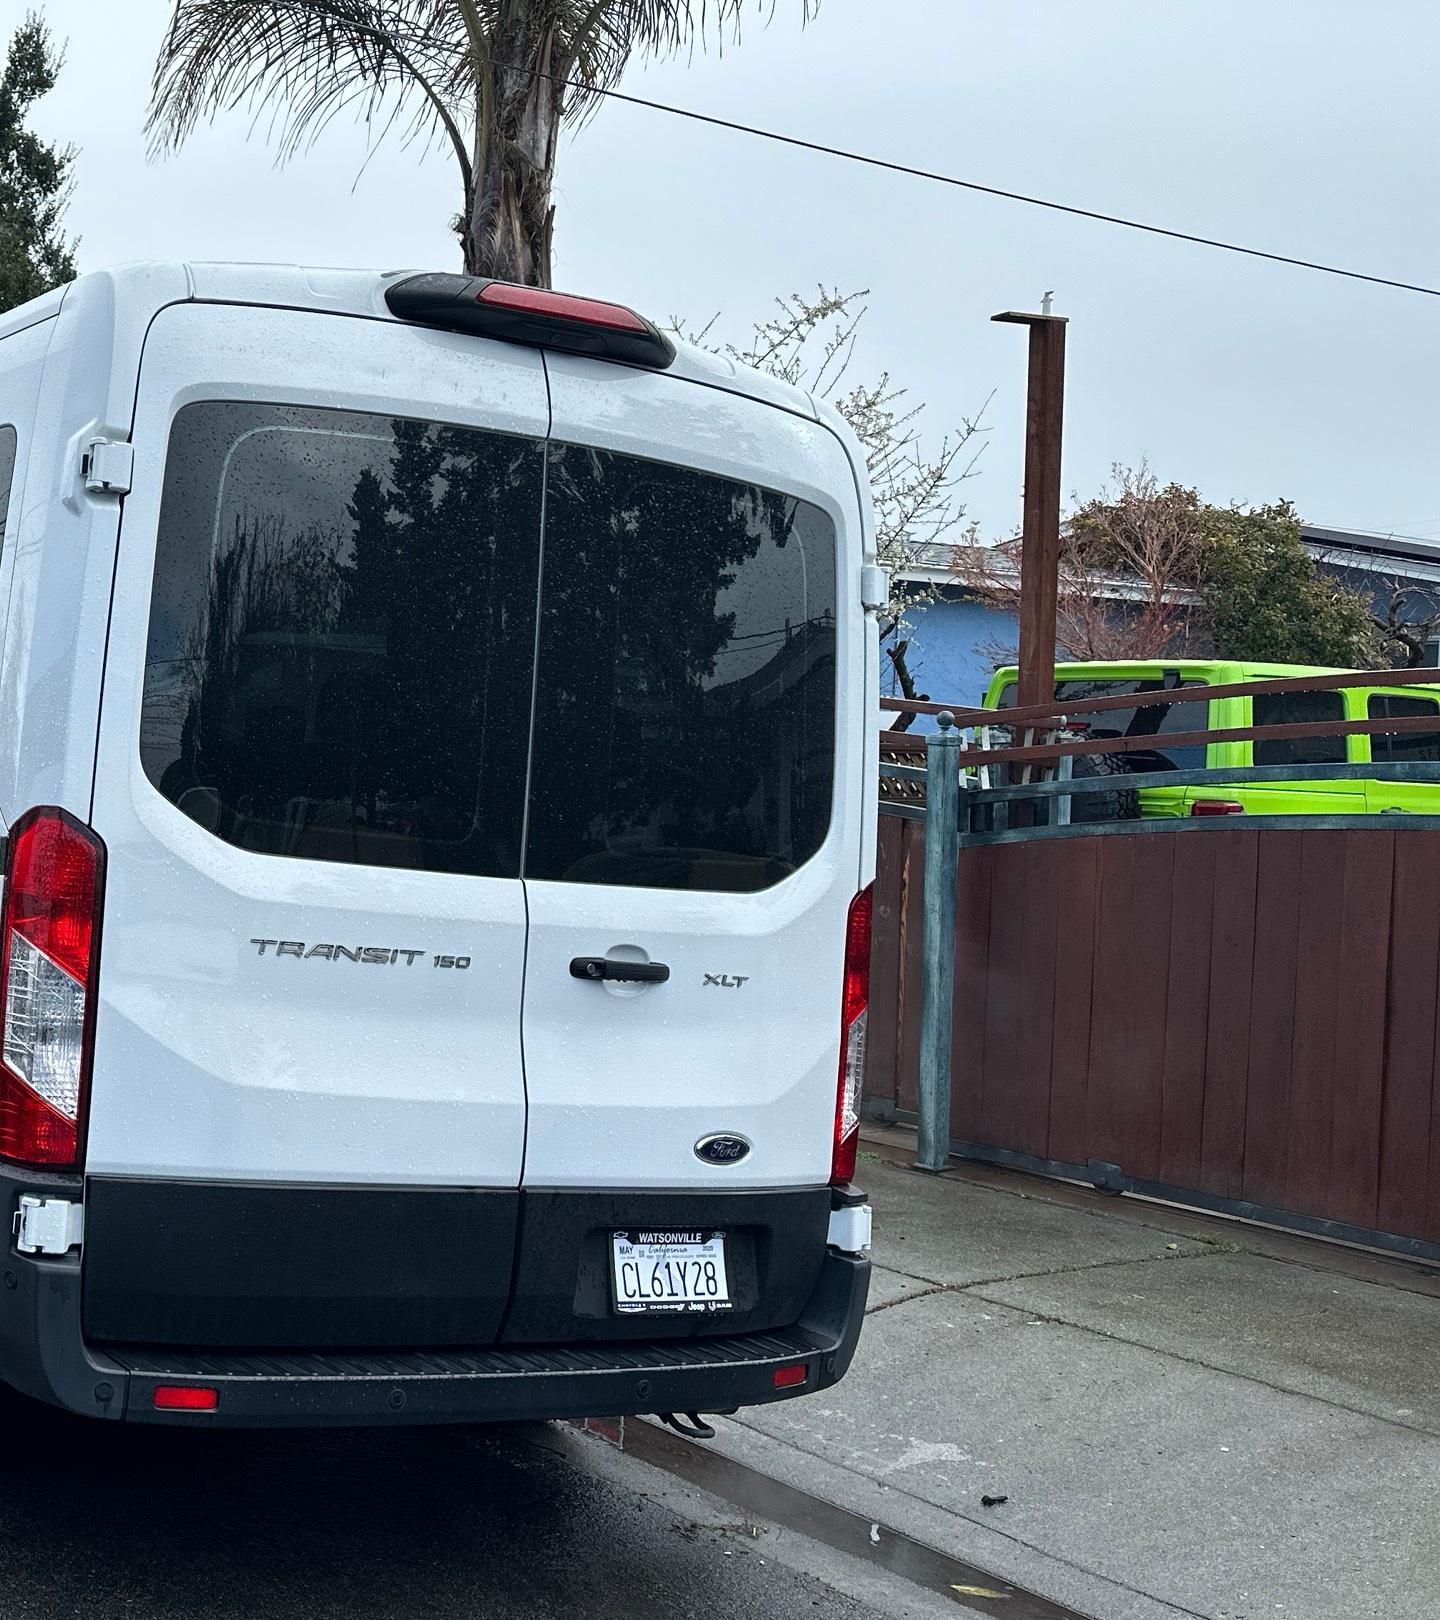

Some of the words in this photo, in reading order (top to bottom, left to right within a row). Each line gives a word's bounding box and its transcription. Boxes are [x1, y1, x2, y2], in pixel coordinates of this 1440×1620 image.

[250, 938, 426, 966] TRANSIT
[433, 954, 471, 970] 150
[703, 973, 750, 988] XLT
[710, 1140, 741, 1158] Ford
[638, 1232, 702, 1243] WATSONVILLE
[619, 1246, 634, 1254] MAY
[648, 1244, 688, 1258] California
[621, 1261, 718, 1298] CL61Y28
[688, 1301, 705, 1312] Jeep
